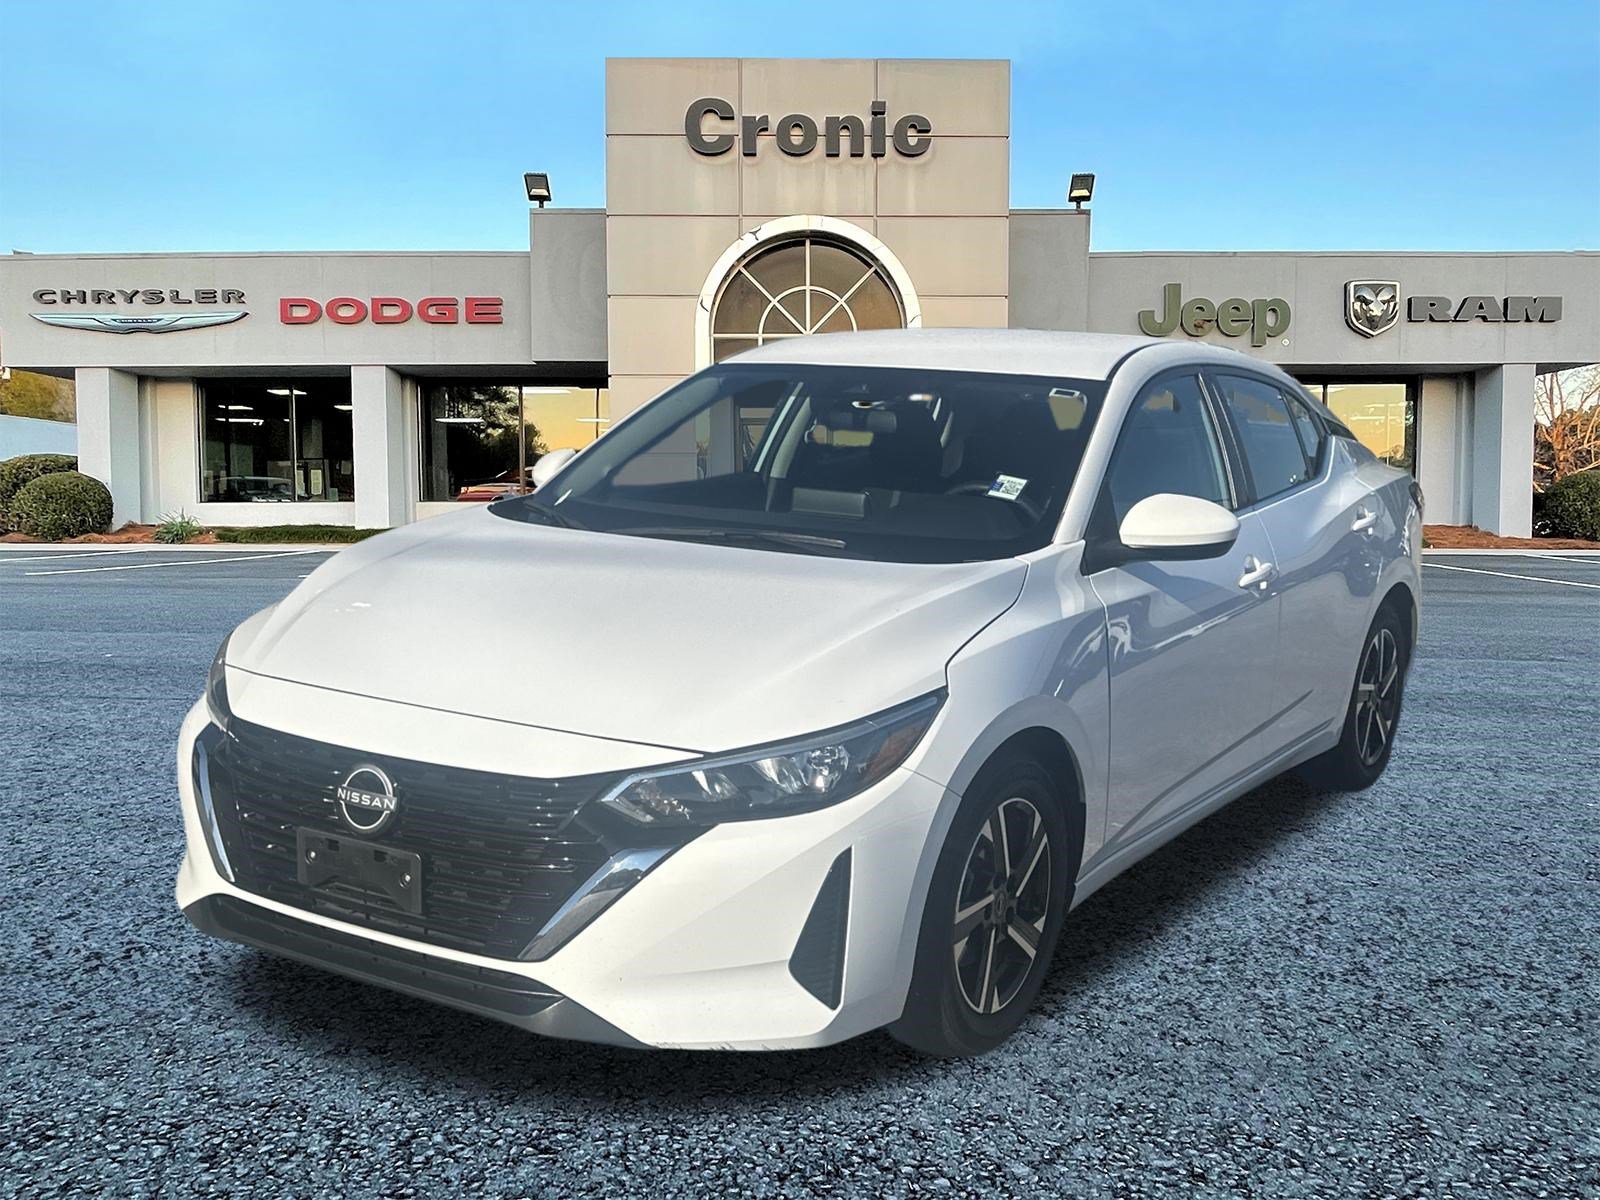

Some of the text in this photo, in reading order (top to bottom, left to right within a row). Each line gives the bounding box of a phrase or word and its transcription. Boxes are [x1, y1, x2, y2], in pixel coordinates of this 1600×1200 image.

[685, 97, 932, 158] Cronic
[32, 289, 246, 304] CHRYSLER
[1407, 296, 1563, 322] RAM
[279, 297, 504, 324] DODGE
[1138, 283, 1291, 347] Jeep
[337, 787, 396, 810] NISSAN
